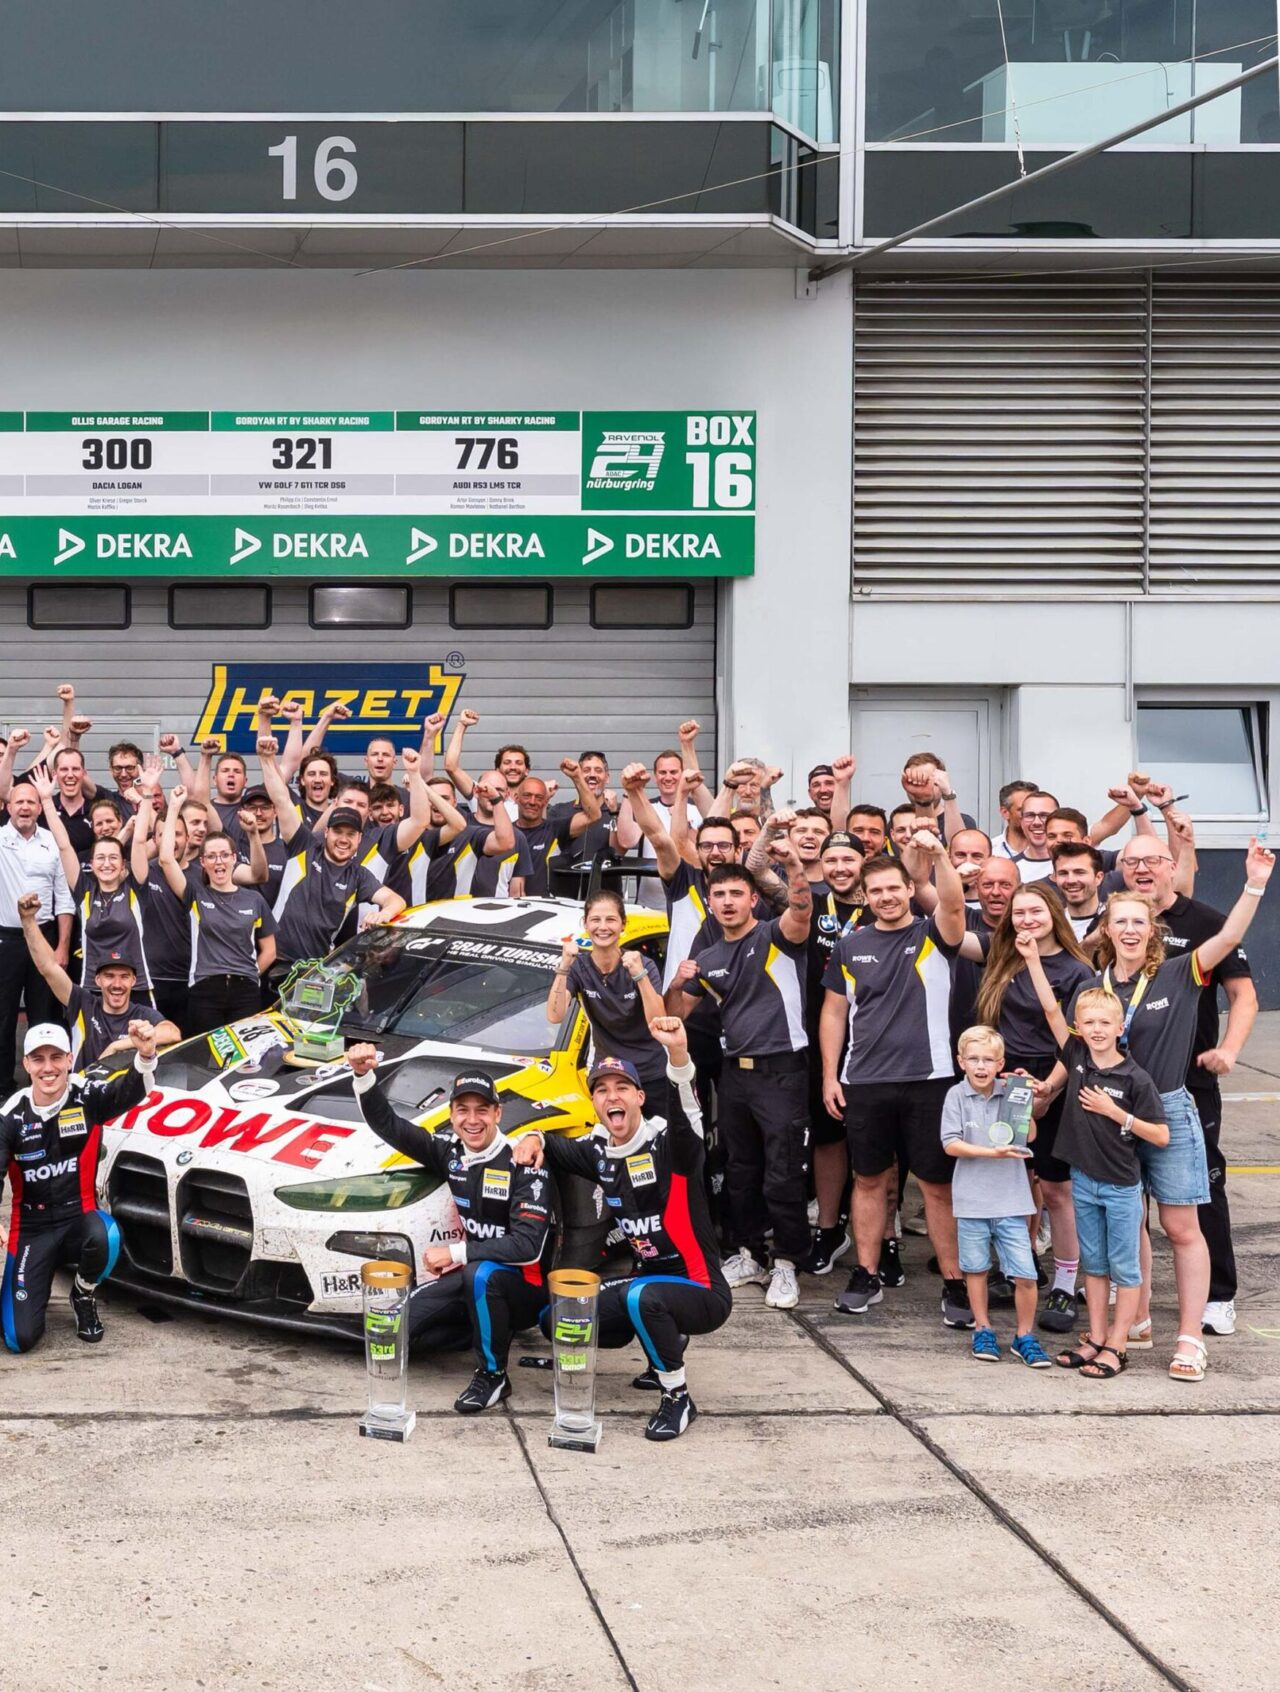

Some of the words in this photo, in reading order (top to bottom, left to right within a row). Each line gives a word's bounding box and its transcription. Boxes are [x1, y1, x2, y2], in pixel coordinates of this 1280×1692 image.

[267, 135, 359, 202] 16
[71, 416, 95, 426] OLLIS
[96, 416, 131, 426] GARAGE
[132, 416, 164, 426] RACING
[235, 416, 276, 426] GOROYAN
[277, 416, 288, 426] RT
[289, 416, 302, 426] BY
[302, 416, 338, 426] SHARKY
[339, 416, 370, 426] RACING
[419, 416, 460, 425] GOROYAN
[461, 416, 473, 425] RT
[474, 416, 486, 425] BY
[487, 416, 523, 425] SHARKY
[524, 416, 556, 425] RACING
[686, 415, 755, 446] BOX
[608, 434, 660, 442] RAVENOL
[81, 438, 153, 470] 300
[272, 437, 332, 470] 321
[454, 437, 519, 470] 776
[589, 444, 666, 478] 24
[92, 481, 116, 490] DACIA
[117, 481, 143, 490] LOGAN
[258, 481, 272, 489] VW
[274, 481, 293, 489] GOLF
[294, 481, 300, 489] 7
[301, 481, 313, 489] GTI
[314, 481, 329, 489] TCR
[330, 481, 346, 489] DSG
[452, 481, 471, 489] AUDI
[473, 481, 488, 489] RS3
[489, 481, 506, 490] LMS
[506, 481, 522, 490] TCR
[586, 478, 655, 491] nürburgring
[685, 452, 753, 508] 16
[96, 532, 193, 559] DEKRA
[273, 532, 370, 558] DEKRA
[449, 532, 546, 558] DEKRA
[625, 533, 722, 559] DEKRA
[221, 687, 437, 731] HAZET
[452, 940, 495, 953] GRAN
[495, 943, 562, 963] TURISM
[515, 959, 560, 970] SIMULATO
[104, 1090, 357, 1170] ROWE
[23, 1156, 78, 1182] ROWE
[429, 1228, 465, 1243] Ansy
[323, 1273, 360, 1293] H&R
[369, 1343, 396, 1355] 53rd
[559, 1352, 587, 1364] 53rd
